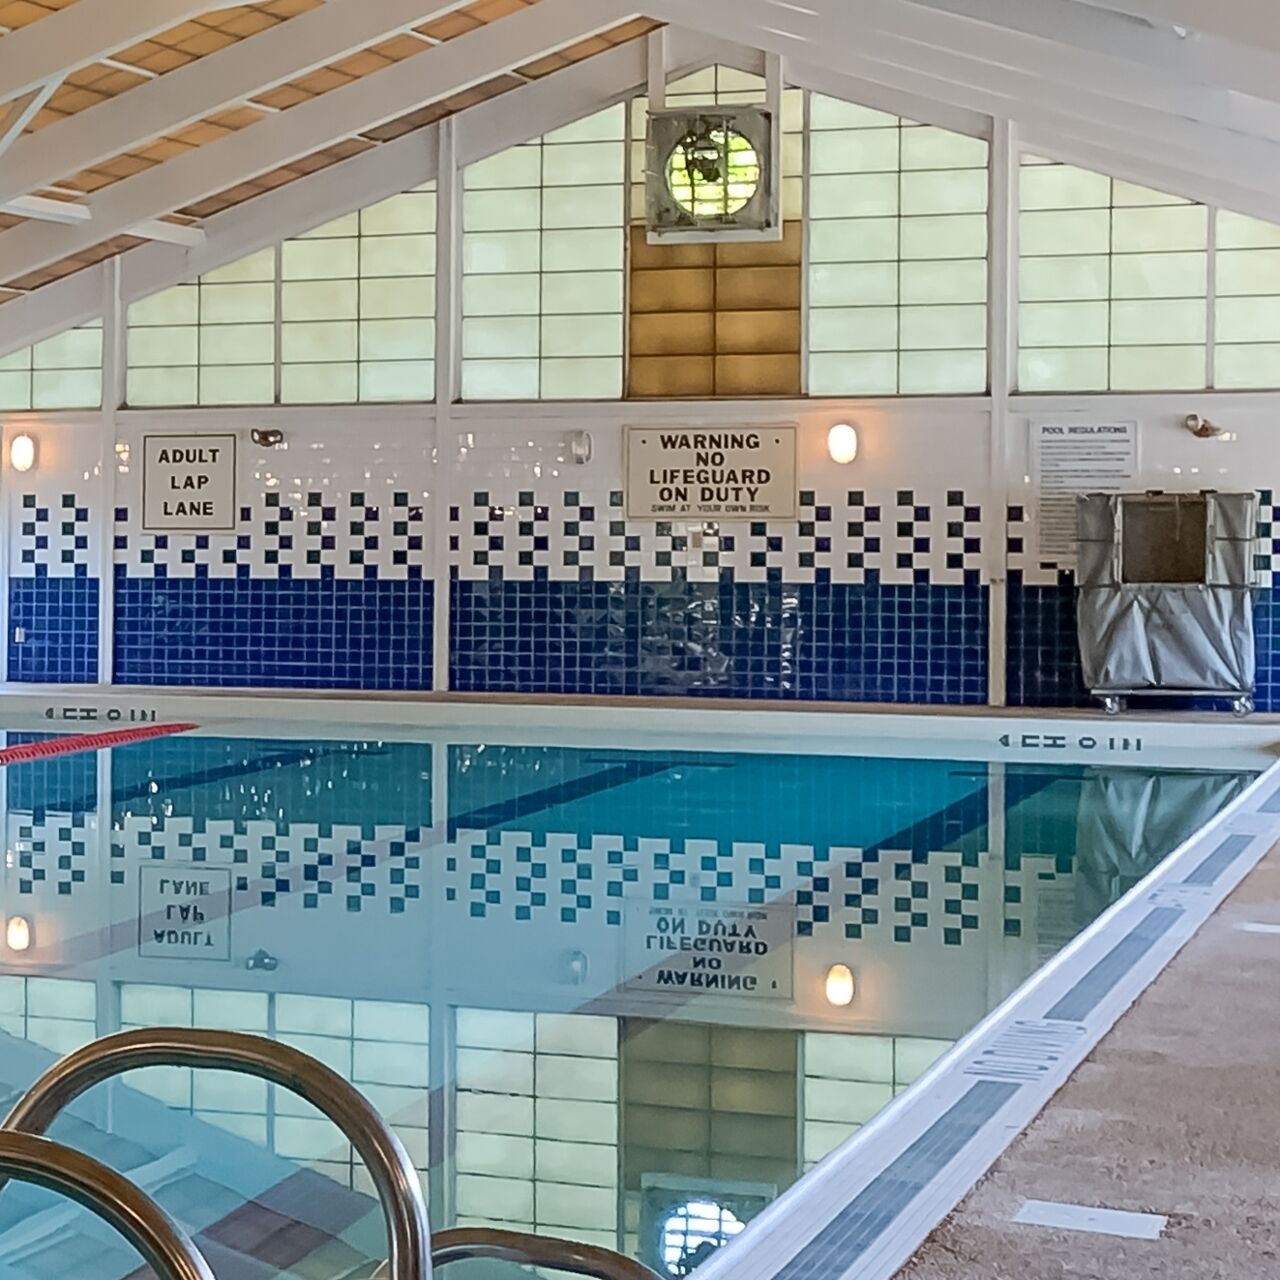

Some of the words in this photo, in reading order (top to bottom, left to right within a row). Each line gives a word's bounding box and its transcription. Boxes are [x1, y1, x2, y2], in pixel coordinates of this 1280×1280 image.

[660, 434, 760, 449] WARNING
[158, 448, 219, 463] ADULT
[696, 452, 725, 467] NO
[171, 475, 209, 489] LAP
[649, 469, 771, 485] LIFEGUARD
[659, 487, 688, 502] ON
[701, 487, 759, 502] DUTY
[163, 501, 213, 516] LANE
[651, 504, 676, 513] SWIM
[680, 504, 691, 513] AT
[697, 504, 722, 513] YOUR
[725, 504, 746, 513] OWN
[749, 504, 770, 513] RISK
